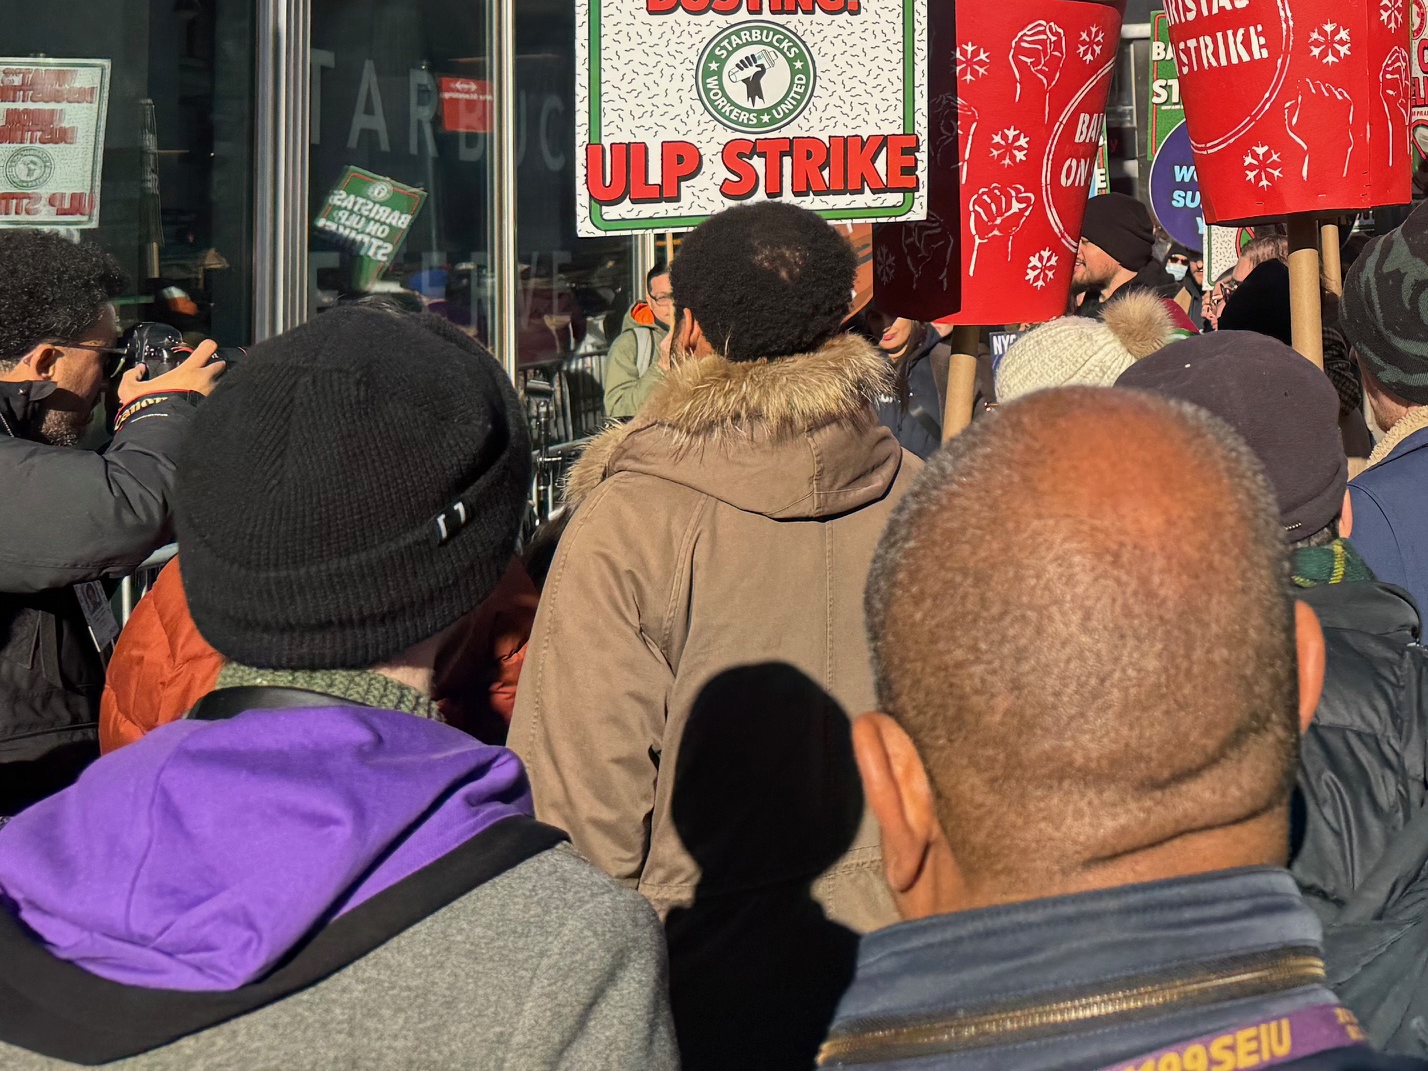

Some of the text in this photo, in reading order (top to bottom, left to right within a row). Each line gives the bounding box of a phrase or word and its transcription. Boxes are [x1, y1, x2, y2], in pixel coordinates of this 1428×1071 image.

[715, 29, 799, 60] STARBUCKS
[1178, 24, 1269, 75] STRIKE
[705, 74, 806, 125] WORKERS UNITED
[586, 134, 919, 204] ULP STRIKE
[1060, 157, 1090, 187] ON
